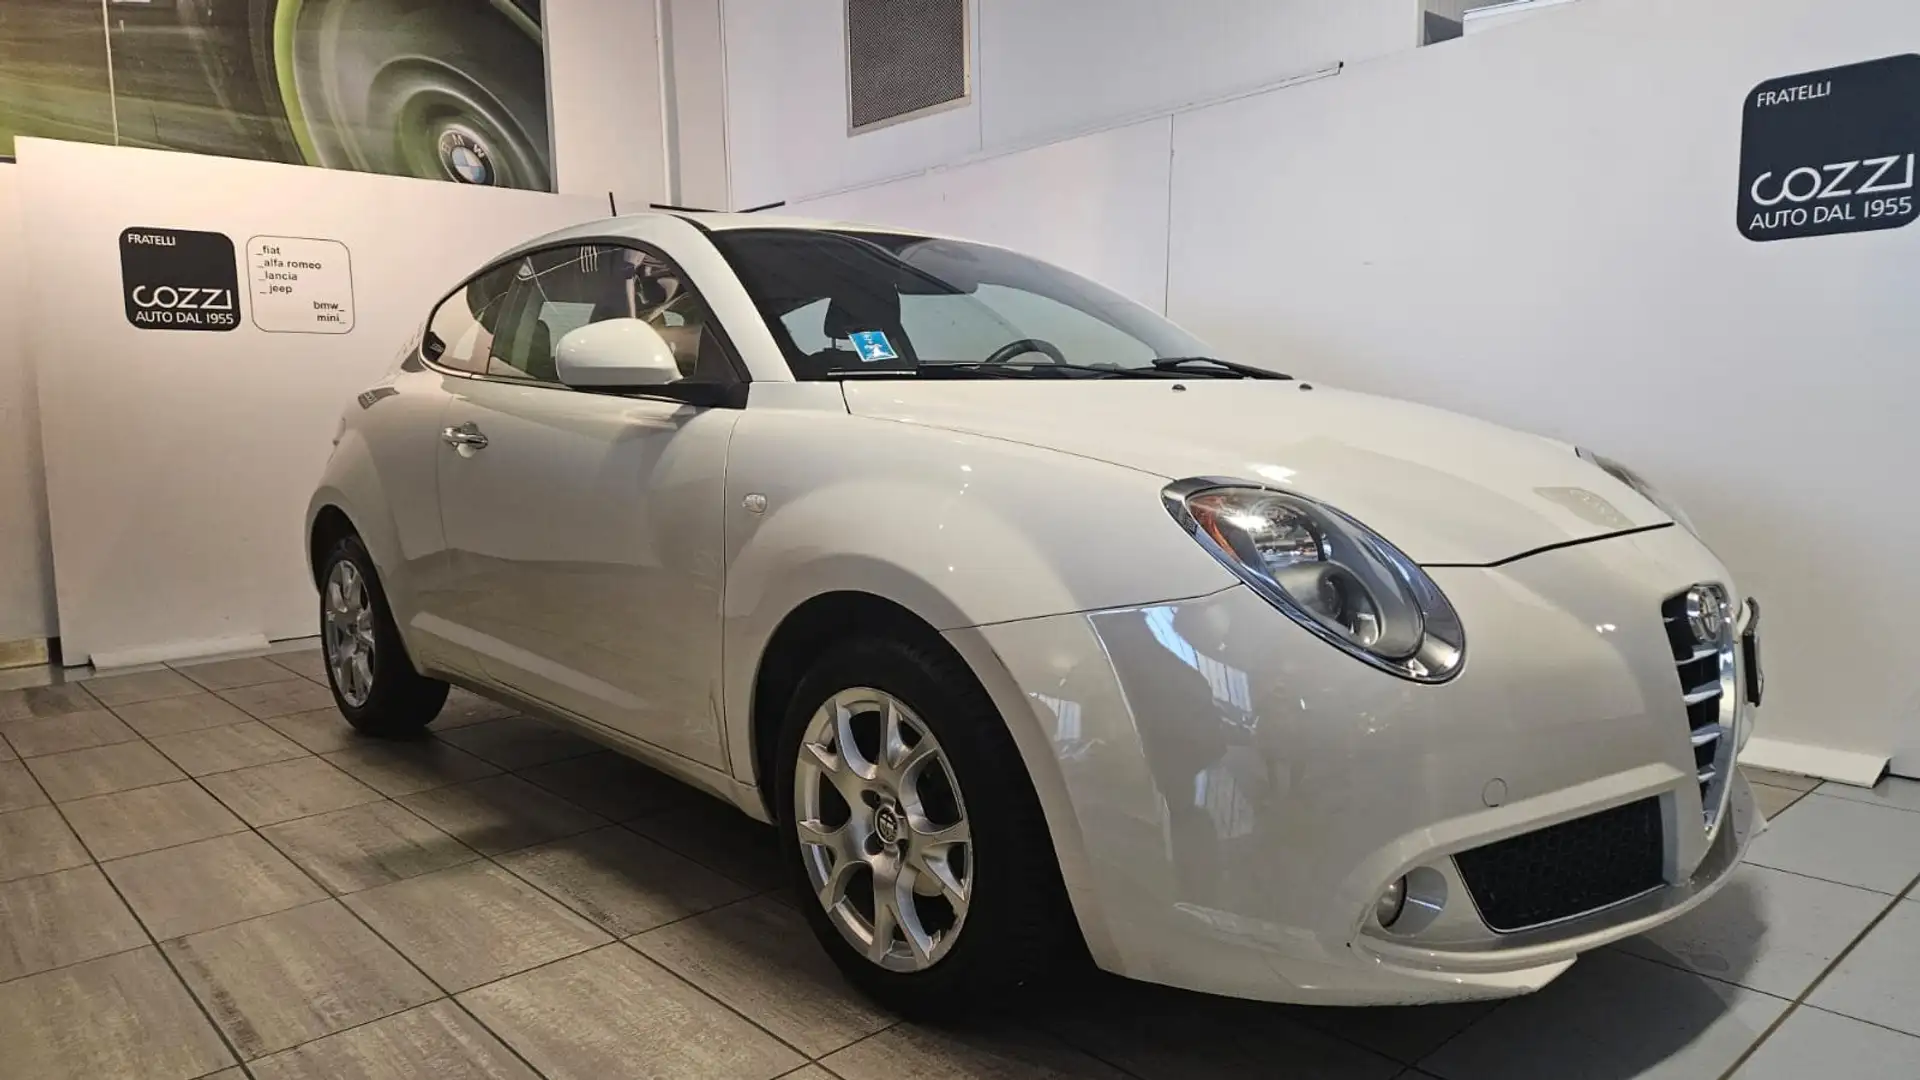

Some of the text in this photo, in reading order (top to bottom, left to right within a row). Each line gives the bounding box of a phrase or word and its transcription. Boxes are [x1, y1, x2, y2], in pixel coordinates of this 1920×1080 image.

[1756, 81, 1832, 108] FRATELLI
[1751, 153, 1914, 206] COZZI
[1749, 196, 1912, 230] AUTO DAL 1955
[128, 233, 176, 246] FRATELLI
[287, 261, 322, 270] romeo
[132, 285, 232, 310] COZZI
[135, 311, 234, 325] AUTO DAL 1955
